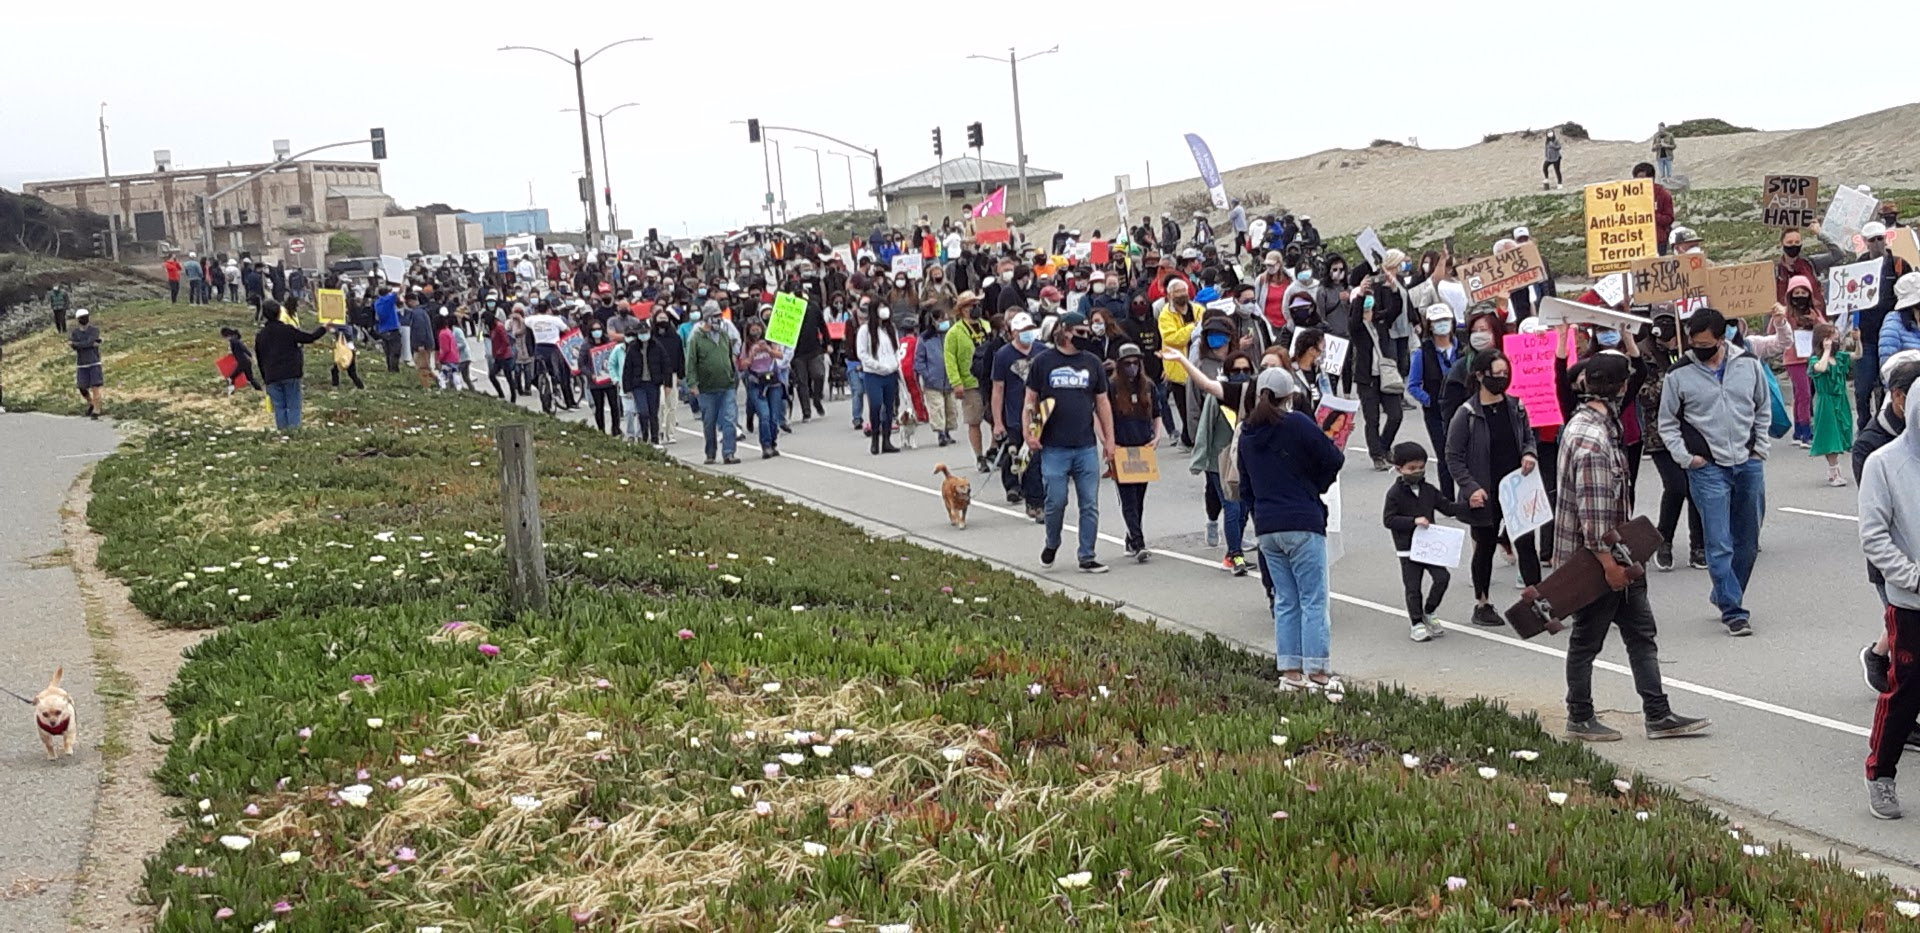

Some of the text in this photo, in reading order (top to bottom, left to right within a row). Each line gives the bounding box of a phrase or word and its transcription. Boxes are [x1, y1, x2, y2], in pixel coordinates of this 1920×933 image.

[1595, 183, 1644, 201] Say No!
[1768, 176, 1810, 196] STOP
[1614, 202, 1626, 212] to
[1768, 194, 1809, 208] Asian
[1590, 212, 1653, 230] Anti-Asian
[1763, 208, 1814, 227] HATE
[1600, 229, 1643, 245] Racist
[1852, 230, 1897, 252] SP
[1599, 243, 1646, 261] Terror!
[1463, 248, 1524, 280] AAPI HATE
[1651, 259, 1680, 279] STOP
[1488, 266, 1505, 281] IS
[1719, 266, 1762, 283] STOP
[1651, 272, 1690, 295] ASIAN
[1720, 285, 1764, 297] ASIAN
[1727, 298, 1755, 310] HATE
[1051, 375, 1088, 388] TSOL
